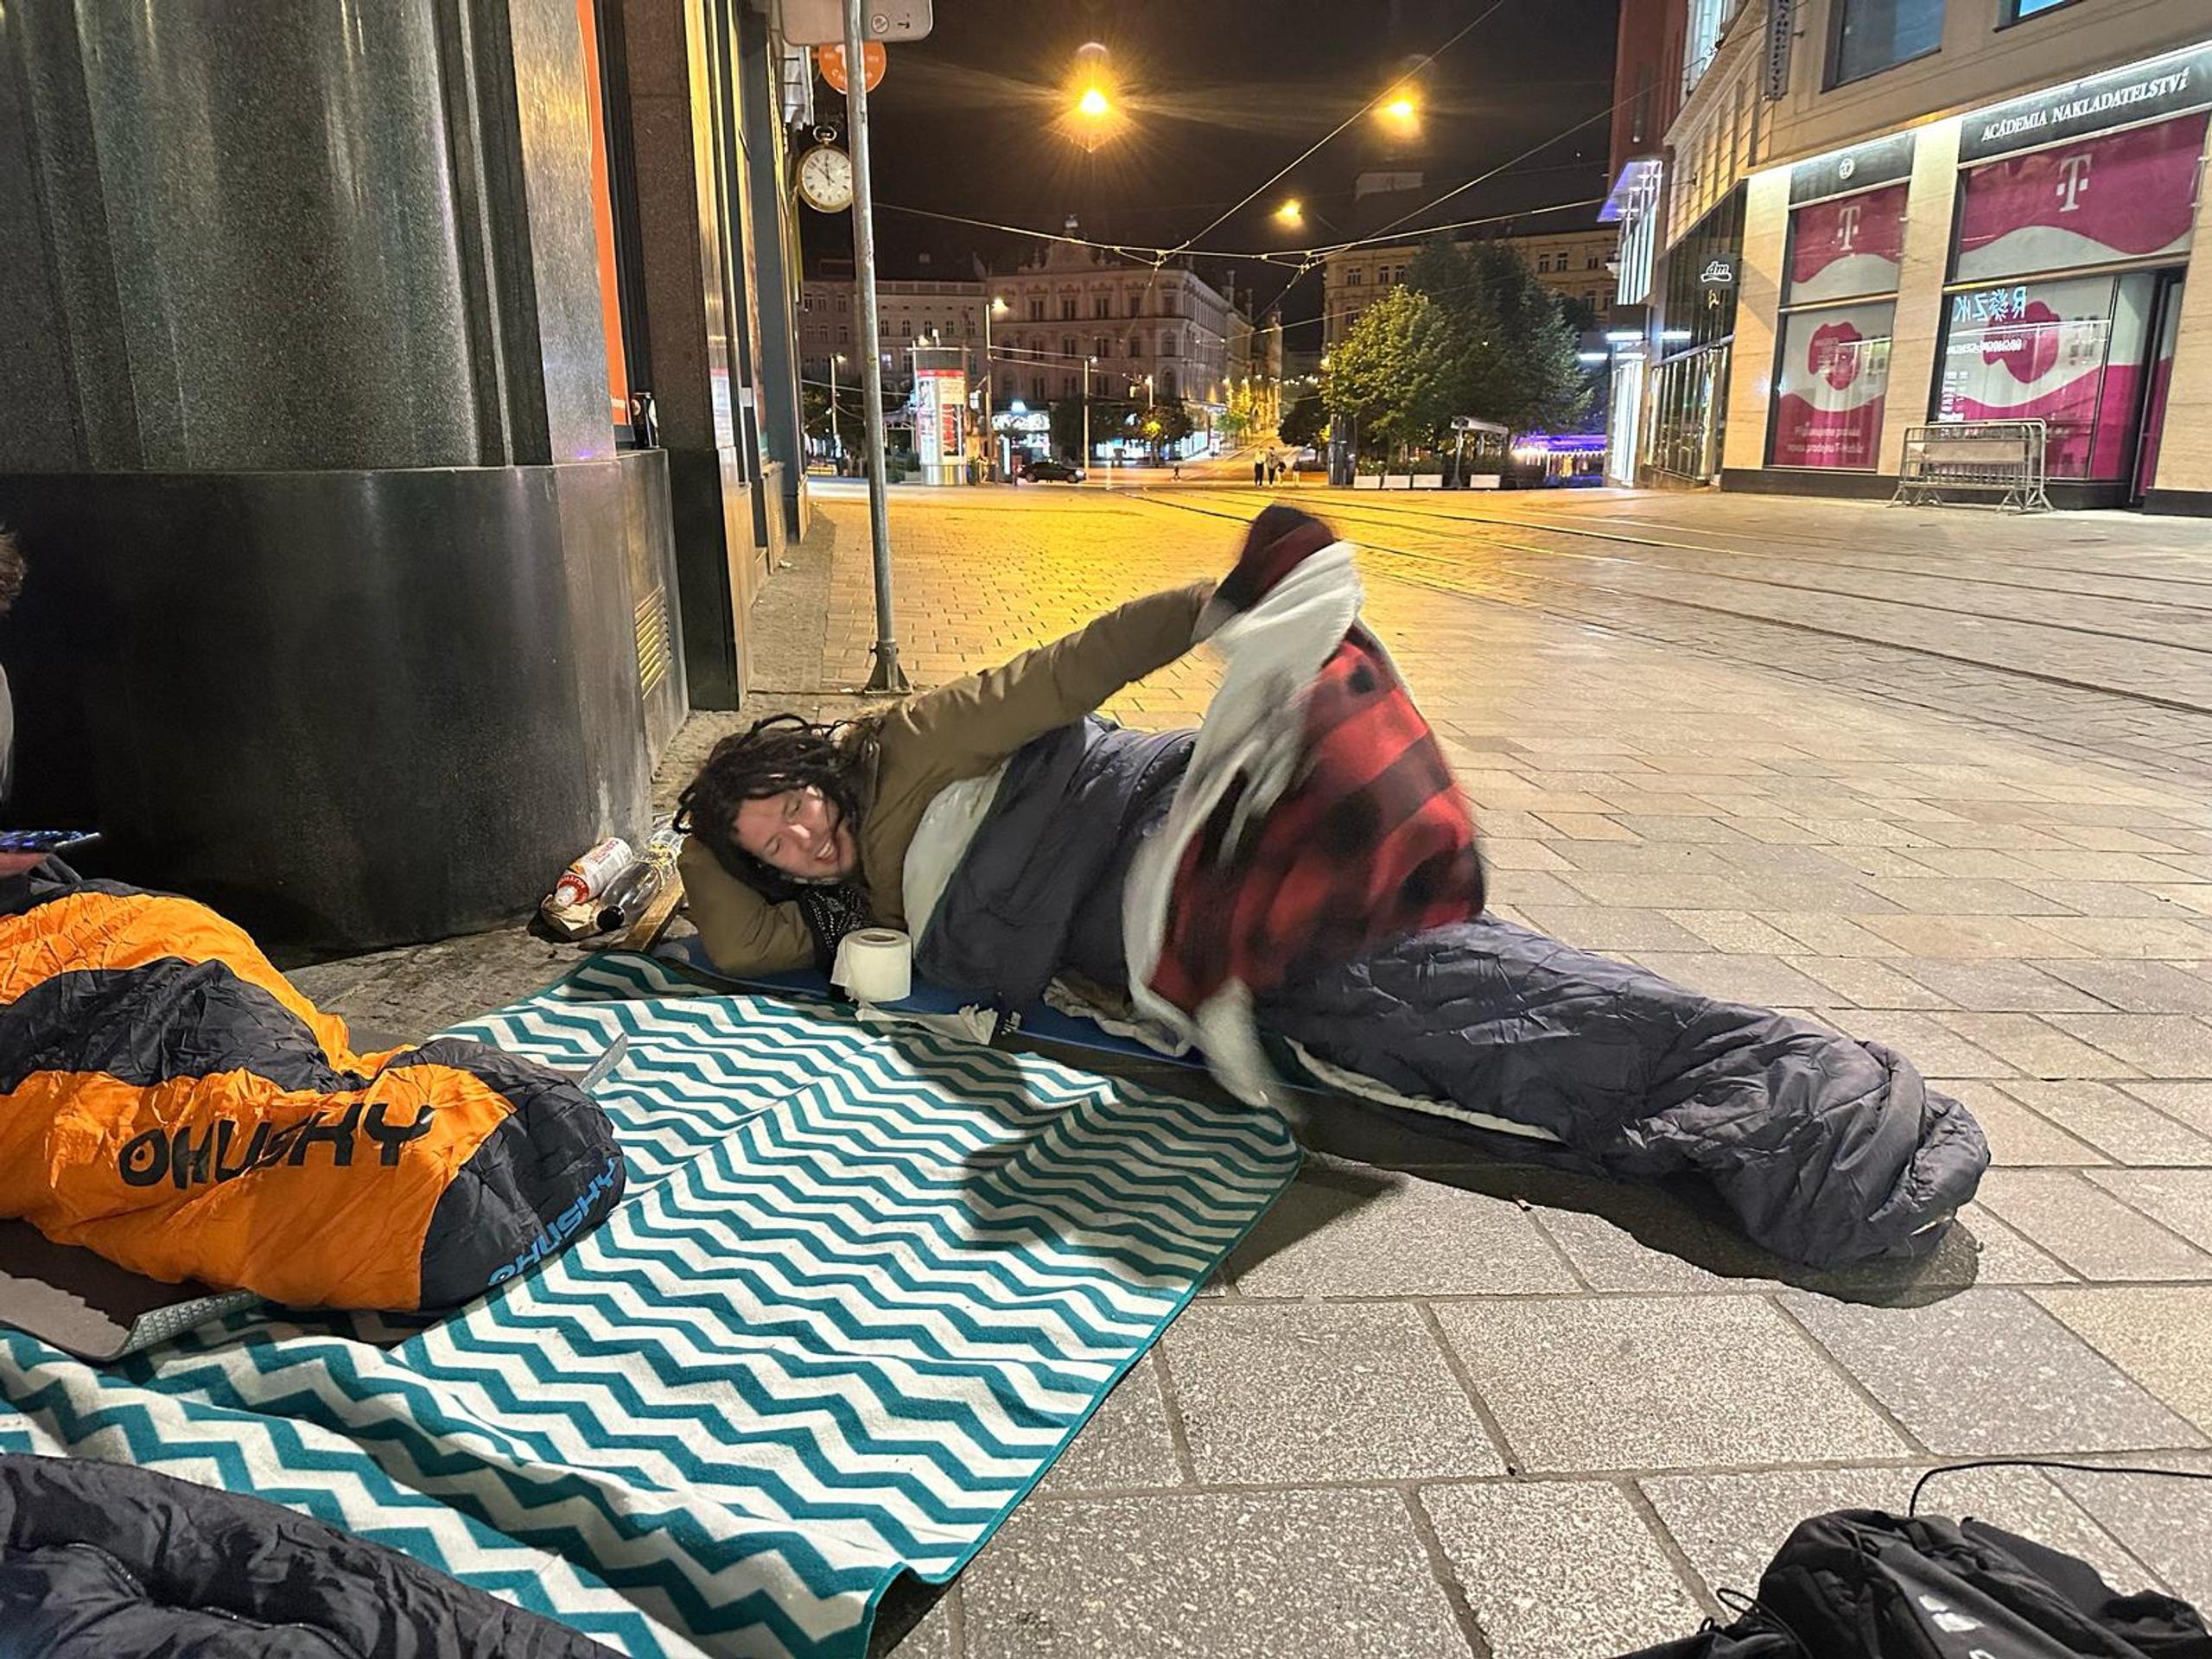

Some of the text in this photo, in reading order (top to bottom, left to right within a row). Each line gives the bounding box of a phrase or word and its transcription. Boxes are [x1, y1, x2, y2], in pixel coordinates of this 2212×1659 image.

[2051, 67, 2190, 123] NAKLADATELSTVÍ
[2056, 154, 2093, 213] T
[1837, 205, 1861, 251] T
[1705, 261, 1730, 276] dm
